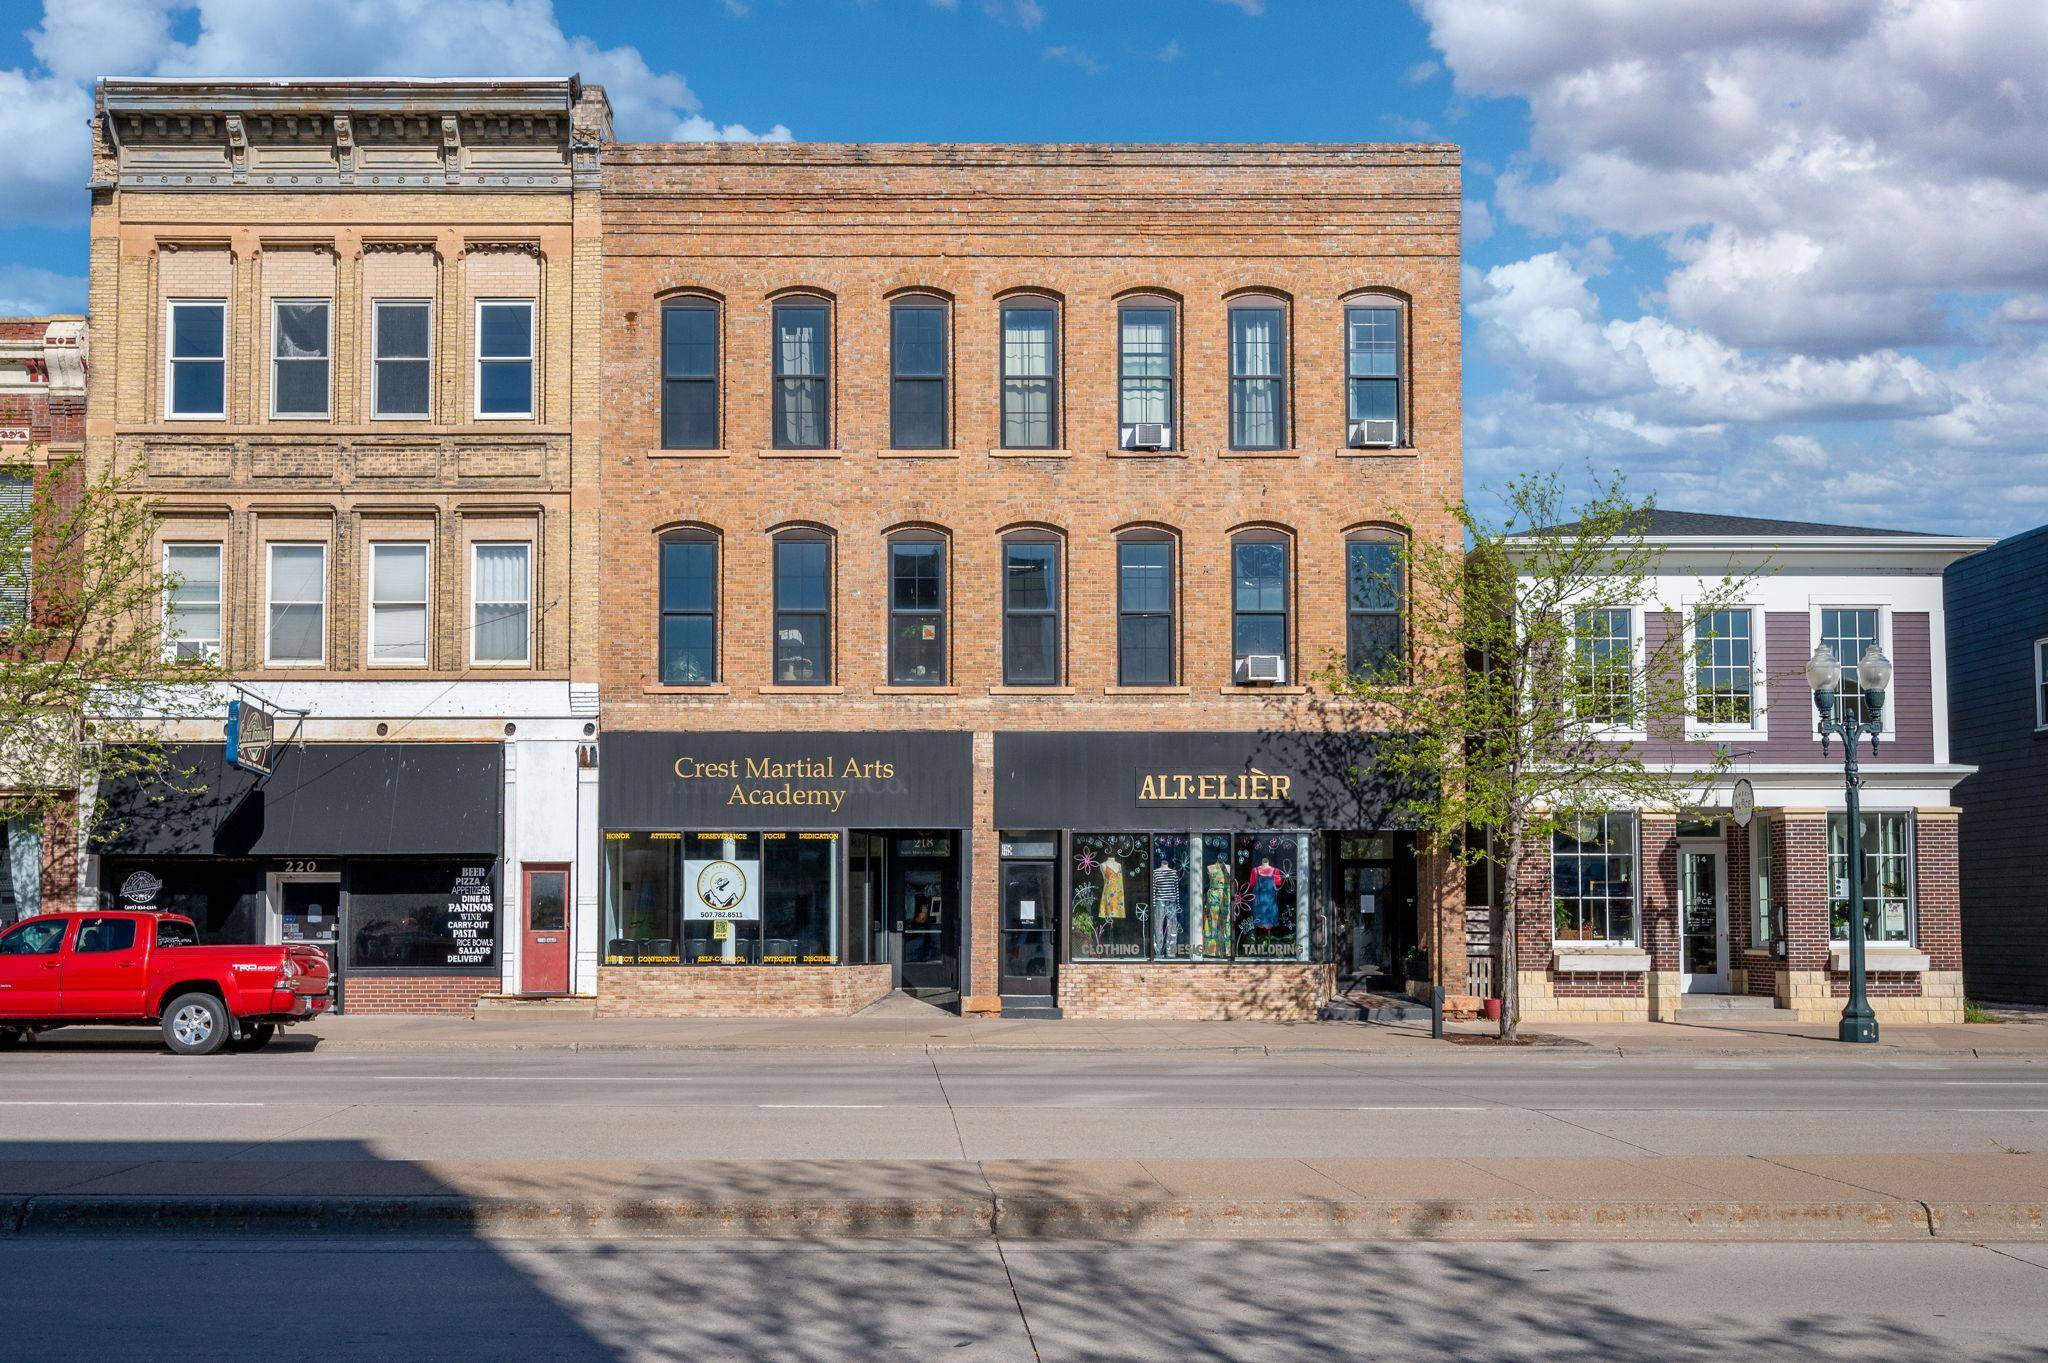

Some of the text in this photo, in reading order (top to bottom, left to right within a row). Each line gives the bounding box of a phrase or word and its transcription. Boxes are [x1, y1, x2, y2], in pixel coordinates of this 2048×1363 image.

[673, 756, 895, 779] Crest Martial Arts
[726, 784, 847, 813] Academy
[606, 832, 631, 840] HONOR
[650, 832, 682, 840] ATTITUDE
[913, 838, 934, 848] 218
[285, 861, 317, 873] 220
[461, 867, 486, 877] BEER
[455, 878, 481, 886] PIZZA
[451, 886, 490, 895] APPETIZERS
[461, 895, 491, 903] DINE-IN
[448, 903, 494, 913] PANINOS
[460, 913, 482, 921] WINE
[447, 921, 490, 929] CARRY-OUT
[452, 929, 478, 938] PASTA
[456, 939, 494, 947] RICE BOWLS
[458, 947, 491, 955] SALADS
[1081, 943, 1140, 956] CLOTHING
[1168, 943, 1212, 956] DESIG
[1242, 943, 1304, 956] TAILORING
[447, 955, 484, 963] DELIVERY
[232, 963, 257, 972] TRD
